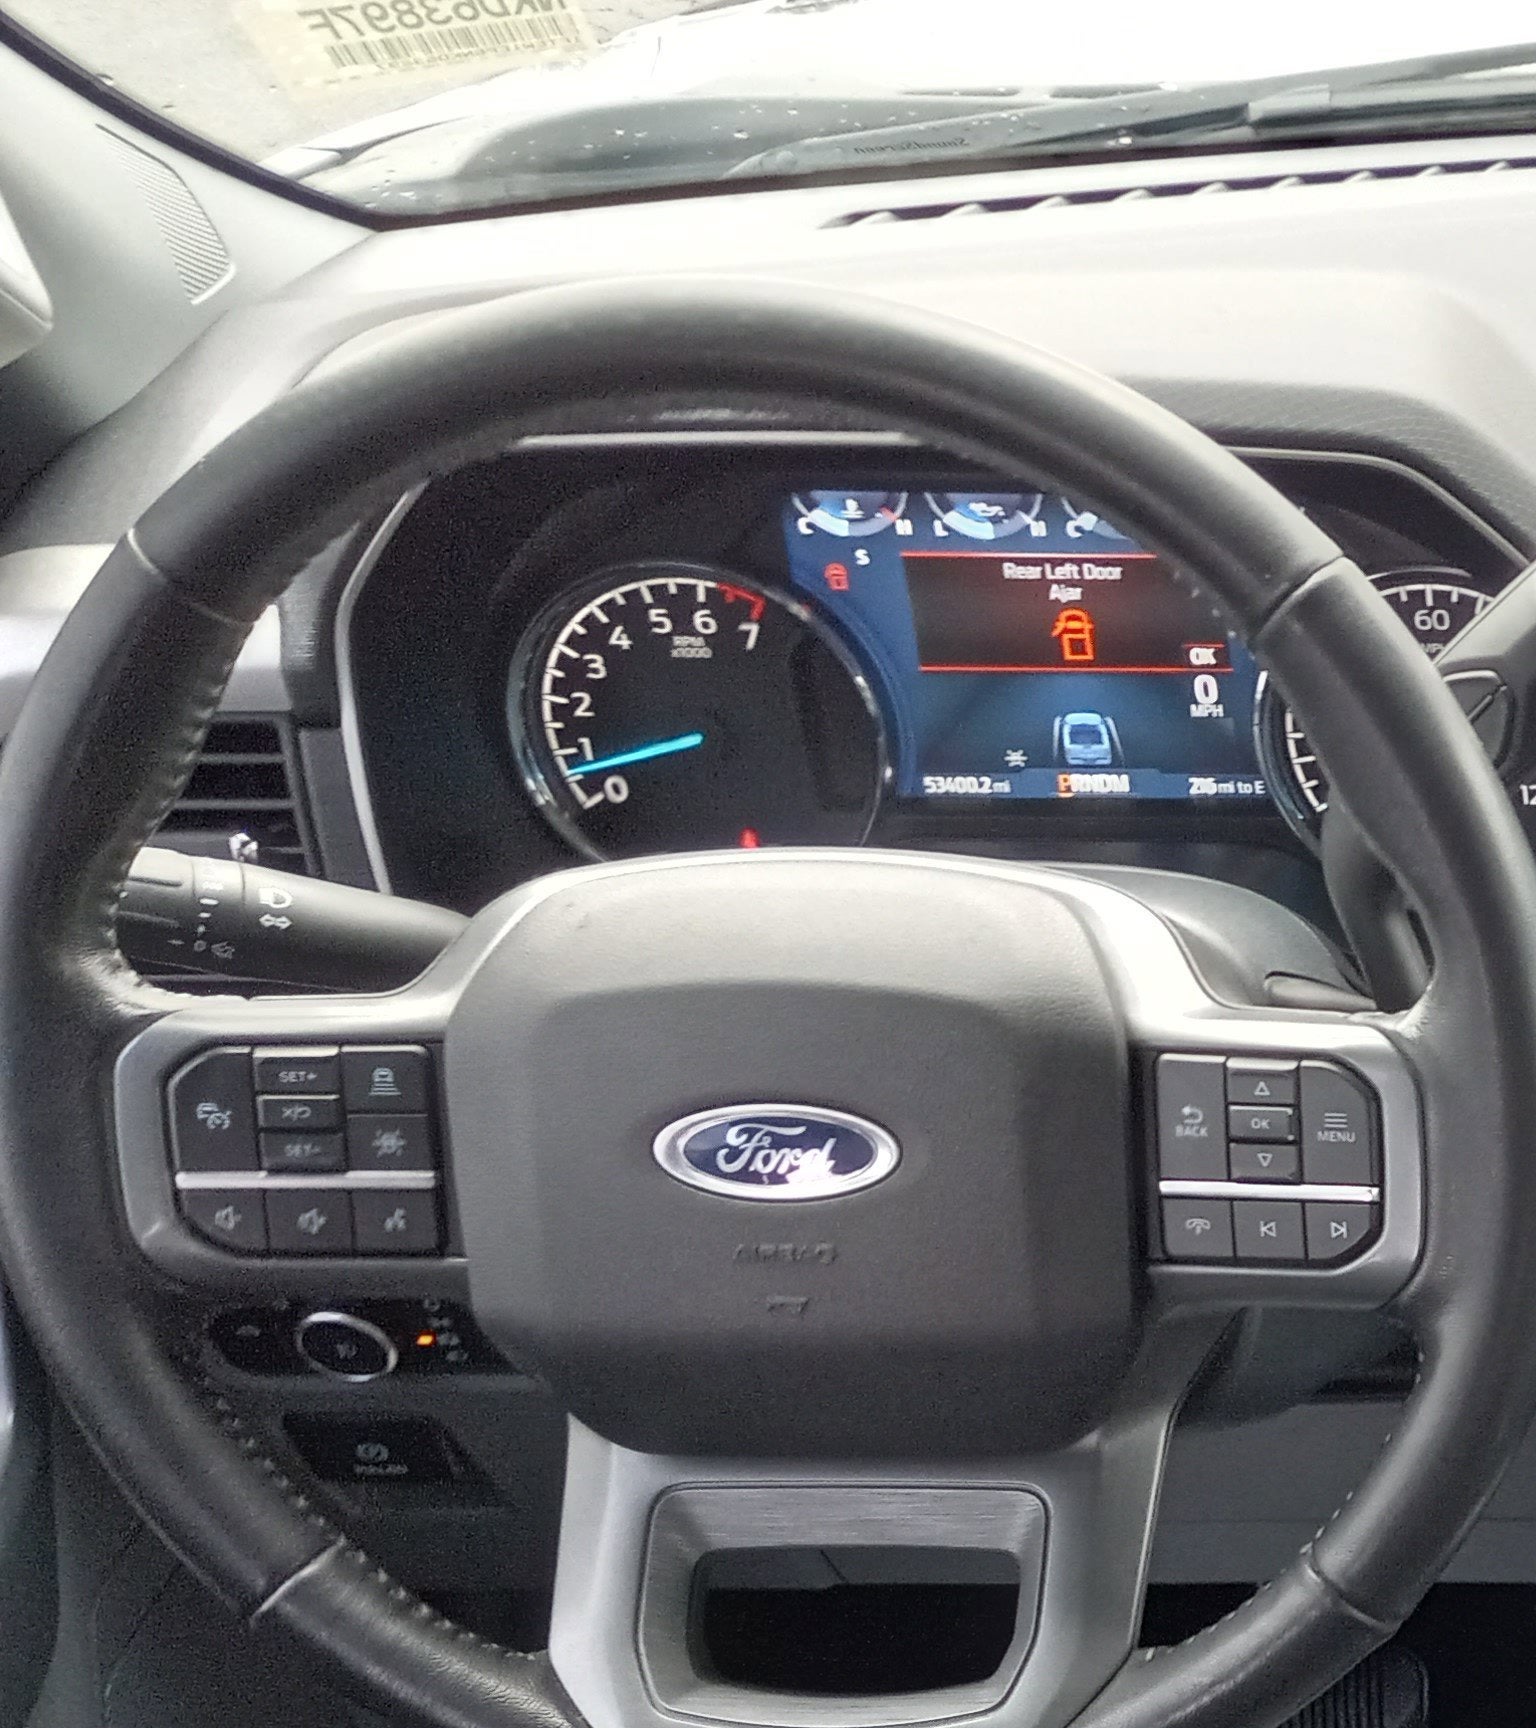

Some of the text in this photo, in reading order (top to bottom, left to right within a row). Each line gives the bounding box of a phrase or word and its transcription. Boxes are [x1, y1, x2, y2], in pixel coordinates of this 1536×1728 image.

[854, 549, 870, 566] S
[1002, 562, 1123, 581] Rear Left Door
[1049, 584, 1083, 603] Ajar
[648, 609, 673, 634] 5
[693, 609, 718, 634] 6
[1414, 609, 1450, 631] 60
[609, 627, 632, 650] 4
[739, 624, 760, 650] 7
[586, 655, 606, 679] 3
[1189, 647, 1216, 666] OK
[1193, 674, 1218, 705] 0
[570, 693, 594, 717] 2
[1190, 704, 1224, 718] MPH
[577, 738, 594, 761] 1
[604, 777, 629, 803] 0
[1175, 1126, 1208, 1137] BACK
[1251, 1118, 1269, 1129] OK
[716, 1122, 838, 1174] Ford
[1317, 1131, 1355, 1143] MENU
